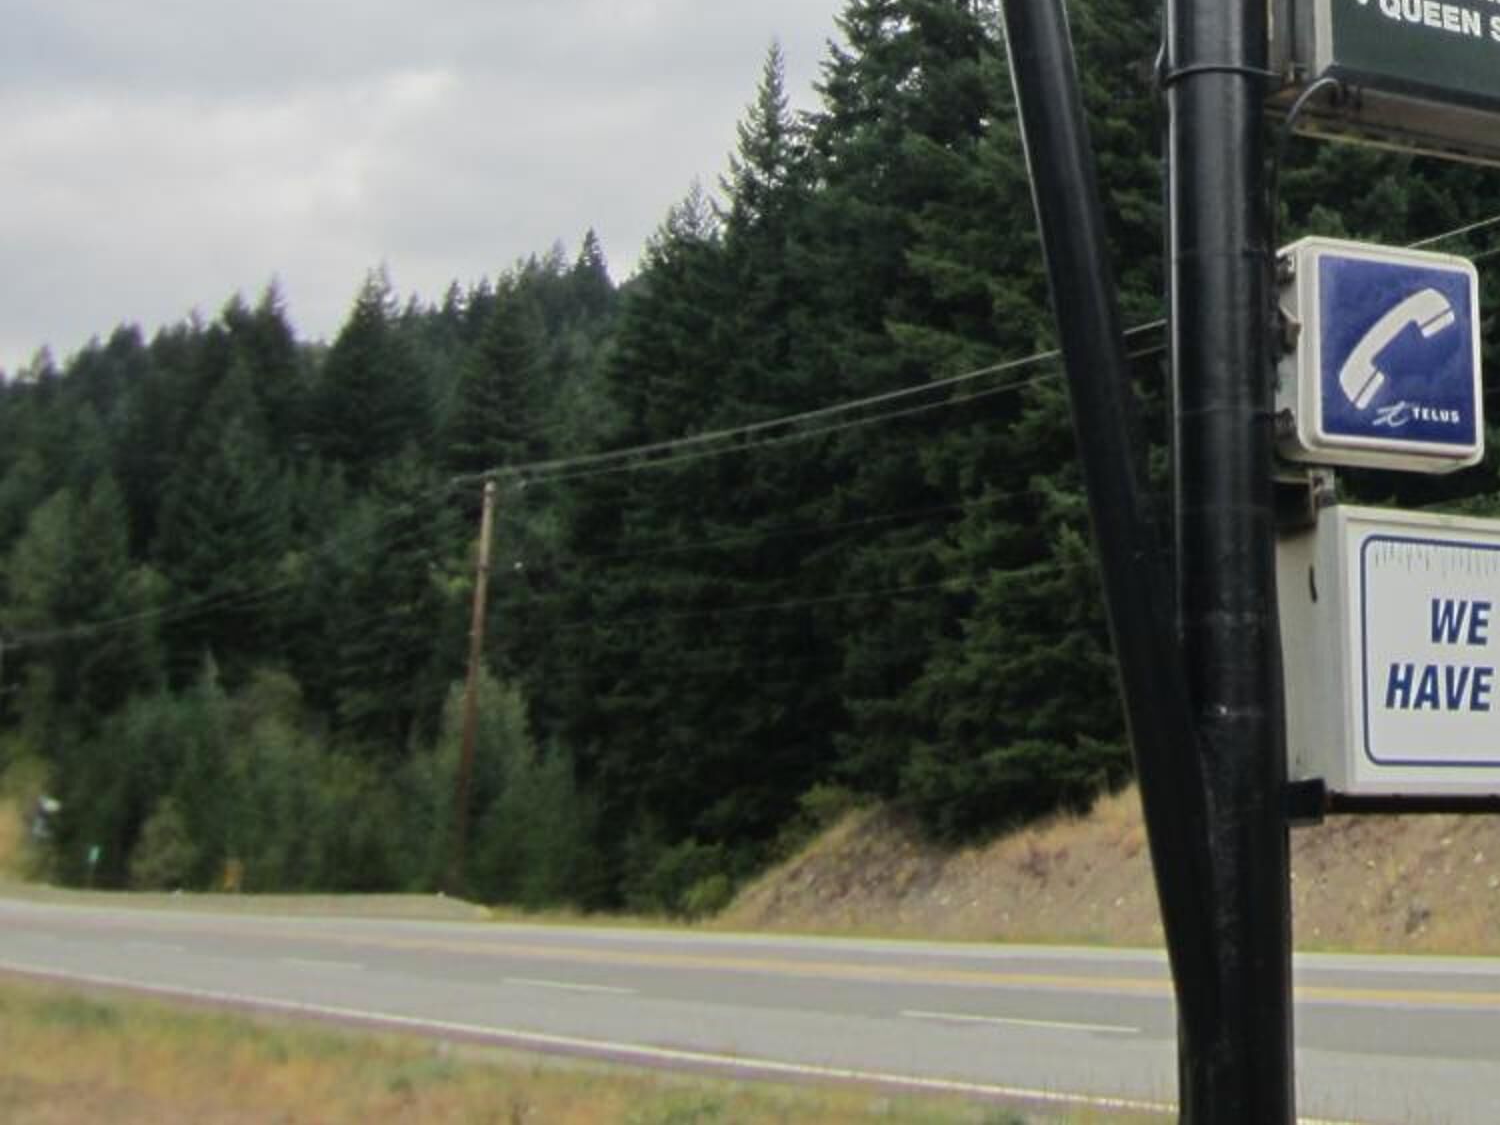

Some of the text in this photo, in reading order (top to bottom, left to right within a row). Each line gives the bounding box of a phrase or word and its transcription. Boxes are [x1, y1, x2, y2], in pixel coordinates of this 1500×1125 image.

[1413, 406, 1460, 424] TELUS
[1430, 597, 1492, 646] WE
[1385, 662, 1494, 713] HAVE
